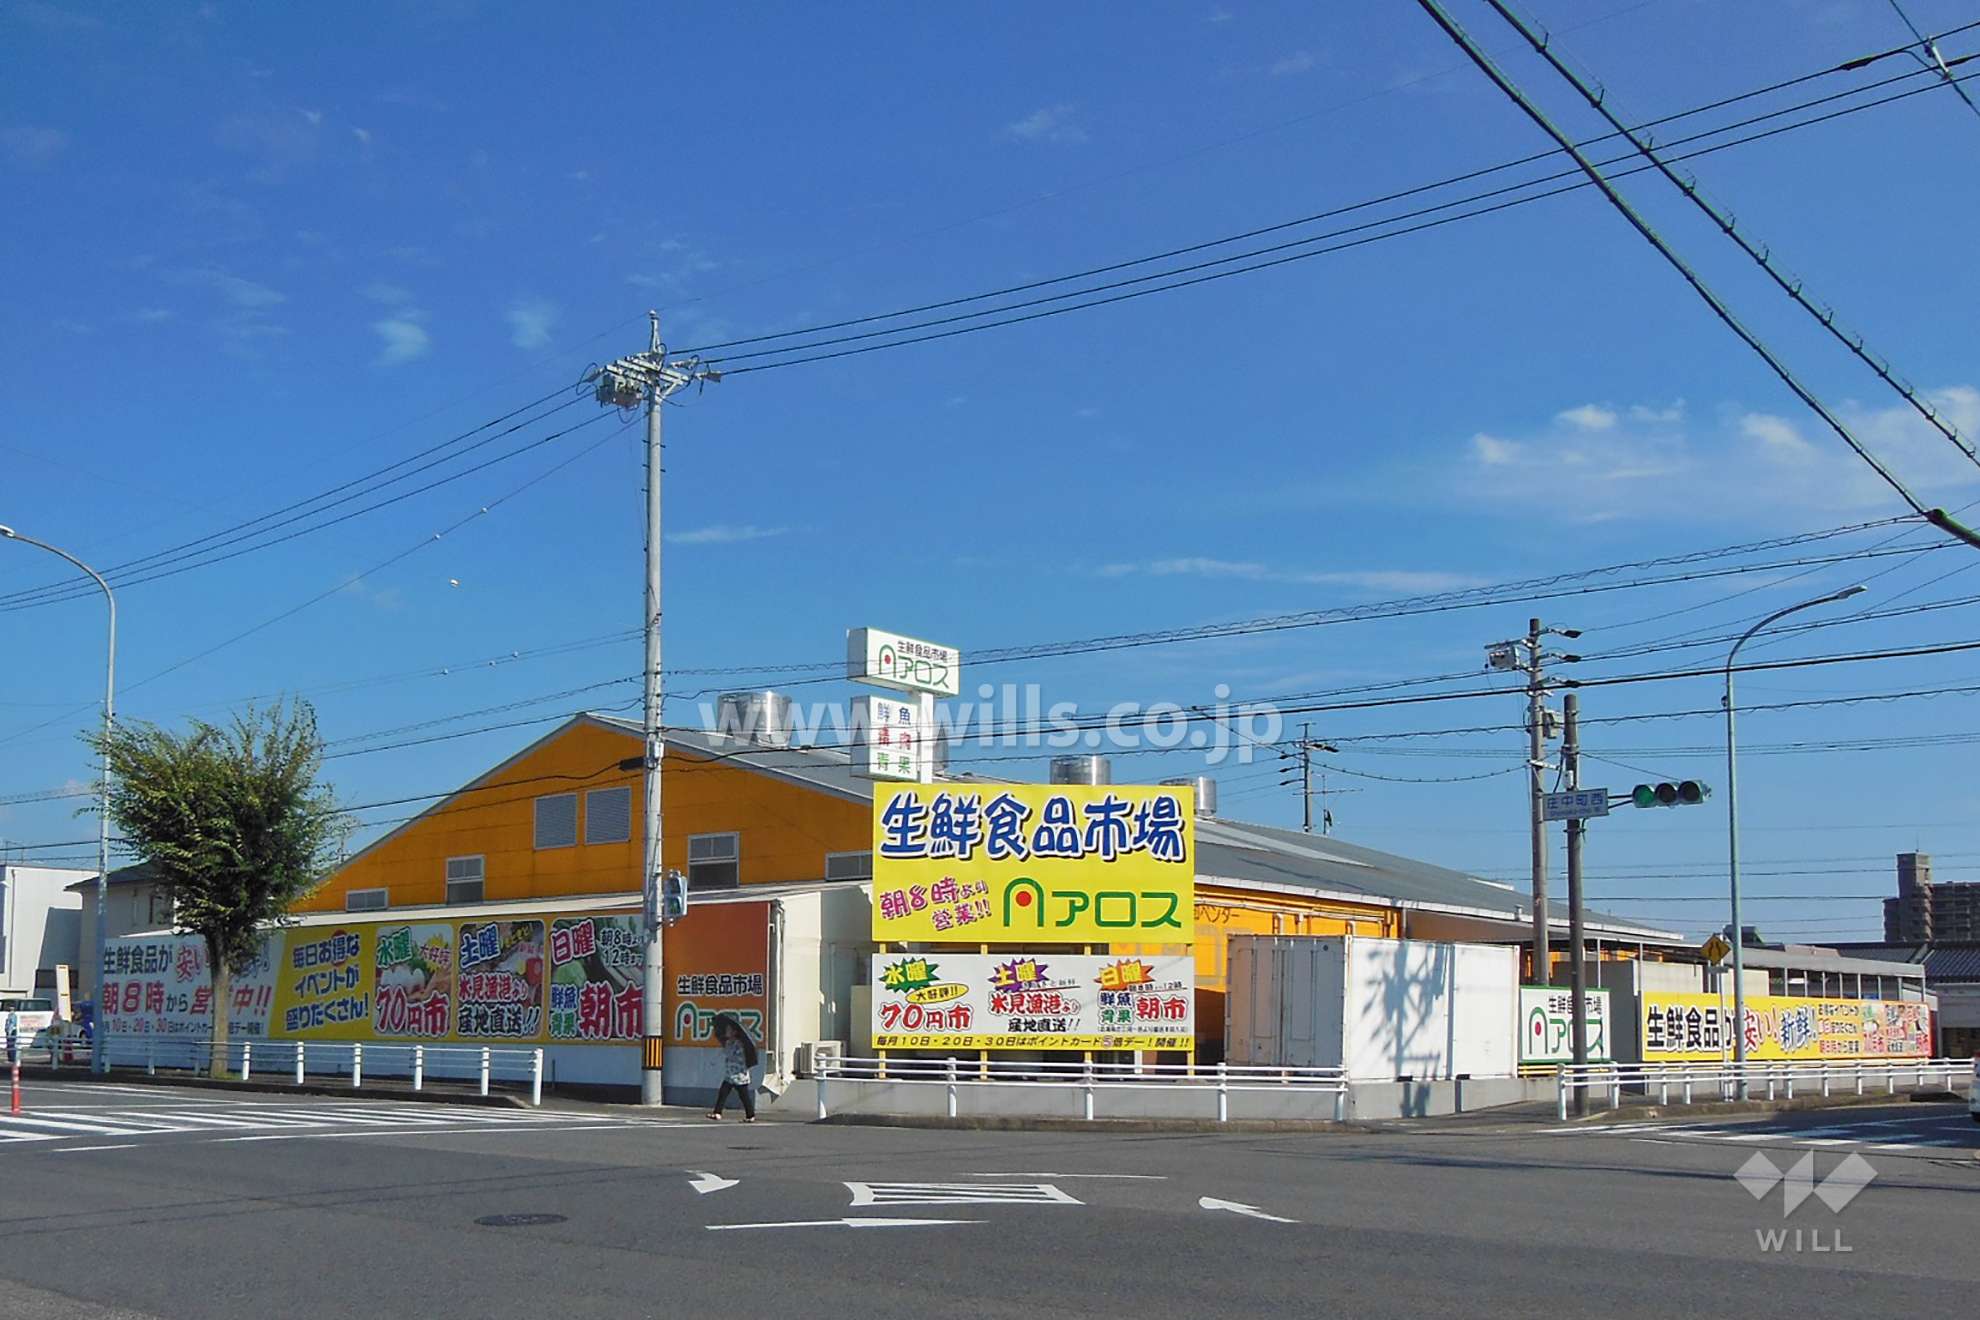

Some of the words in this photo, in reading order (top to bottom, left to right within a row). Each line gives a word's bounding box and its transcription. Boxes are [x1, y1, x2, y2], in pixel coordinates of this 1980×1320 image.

[897, 640, 949, 661] 生鮮食品市場
[879, 792, 1186, 861] 生鮮食品市場
[879, 876, 989, 920] 朝8時より
[1051, 890, 1182, 928] アロス
[932, 898, 992, 931] 営業!!
[293, 934, 360, 969] 毎日お得な
[377, 927, 412, 969] 水曜
[460, 922, 500, 968] 土曜
[551, 919, 595, 965] 日曜
[295, 965, 359, 999] イベントが
[677, 974, 763, 995] 生鮮食品市場
[881, 960, 928, 984] 水曜
[994, 961, 1037, 986] 土曜
[1101, 961, 1143, 985] 日曜
[550, 984, 578, 1009] 鮮魚
[916, 986, 959, 1001] 大好評!!
[1100, 992, 1132, 1007] 鮮魚
[1135, 996, 1187, 1021] 朝市
[286, 992, 369, 1031] 盛りだくさん!
[376, 985, 450, 1037] 70円市
[457, 1004, 541, 1036] 産地直送!!
[550, 1012, 577, 1036] 青果
[579, 980, 644, 1040] 朝市
[879, 1002, 972, 1032] 70円市
[1008, 1017, 1081, 1033] 産地直送!!
[1100, 1008, 1132, 1024] 青果
